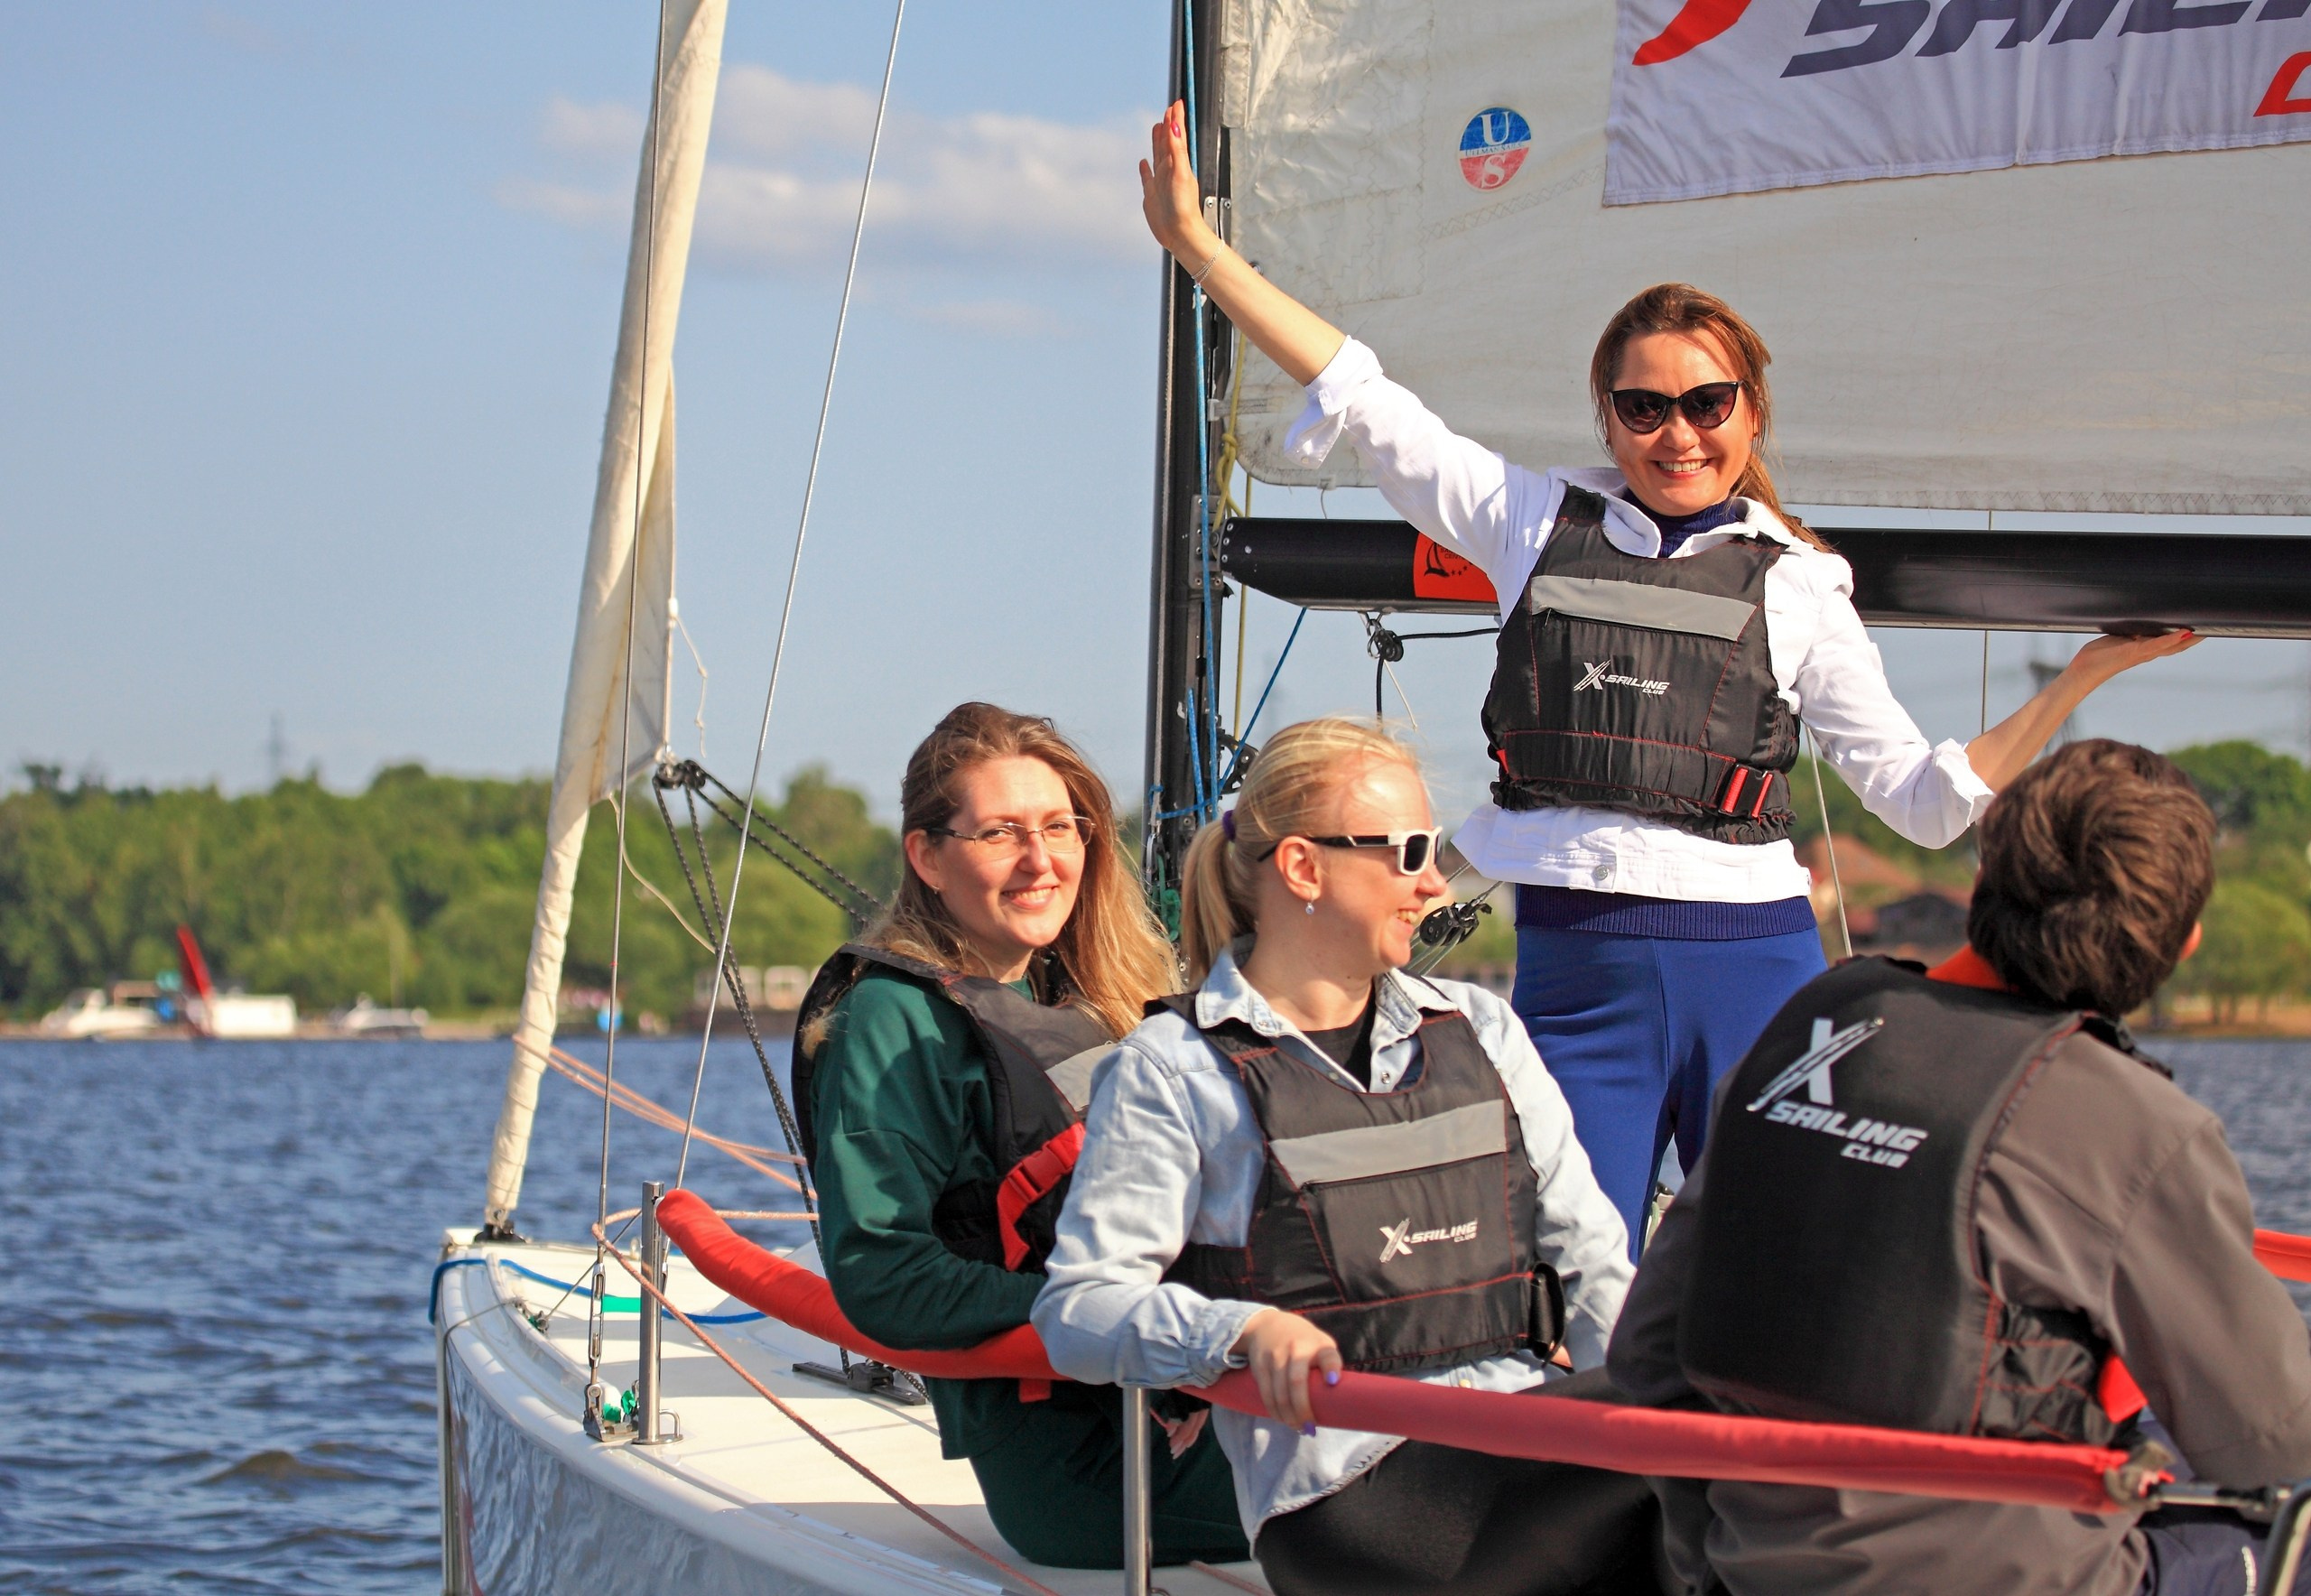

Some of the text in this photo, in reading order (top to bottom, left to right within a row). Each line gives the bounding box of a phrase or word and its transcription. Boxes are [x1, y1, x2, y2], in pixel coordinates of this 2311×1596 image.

[1480, 111, 1510, 145] U
[1481, 154, 1506, 188] S
[1765, 1100, 1928, 1152] SAILING
[1841, 1143, 1909, 1168] CLUB
